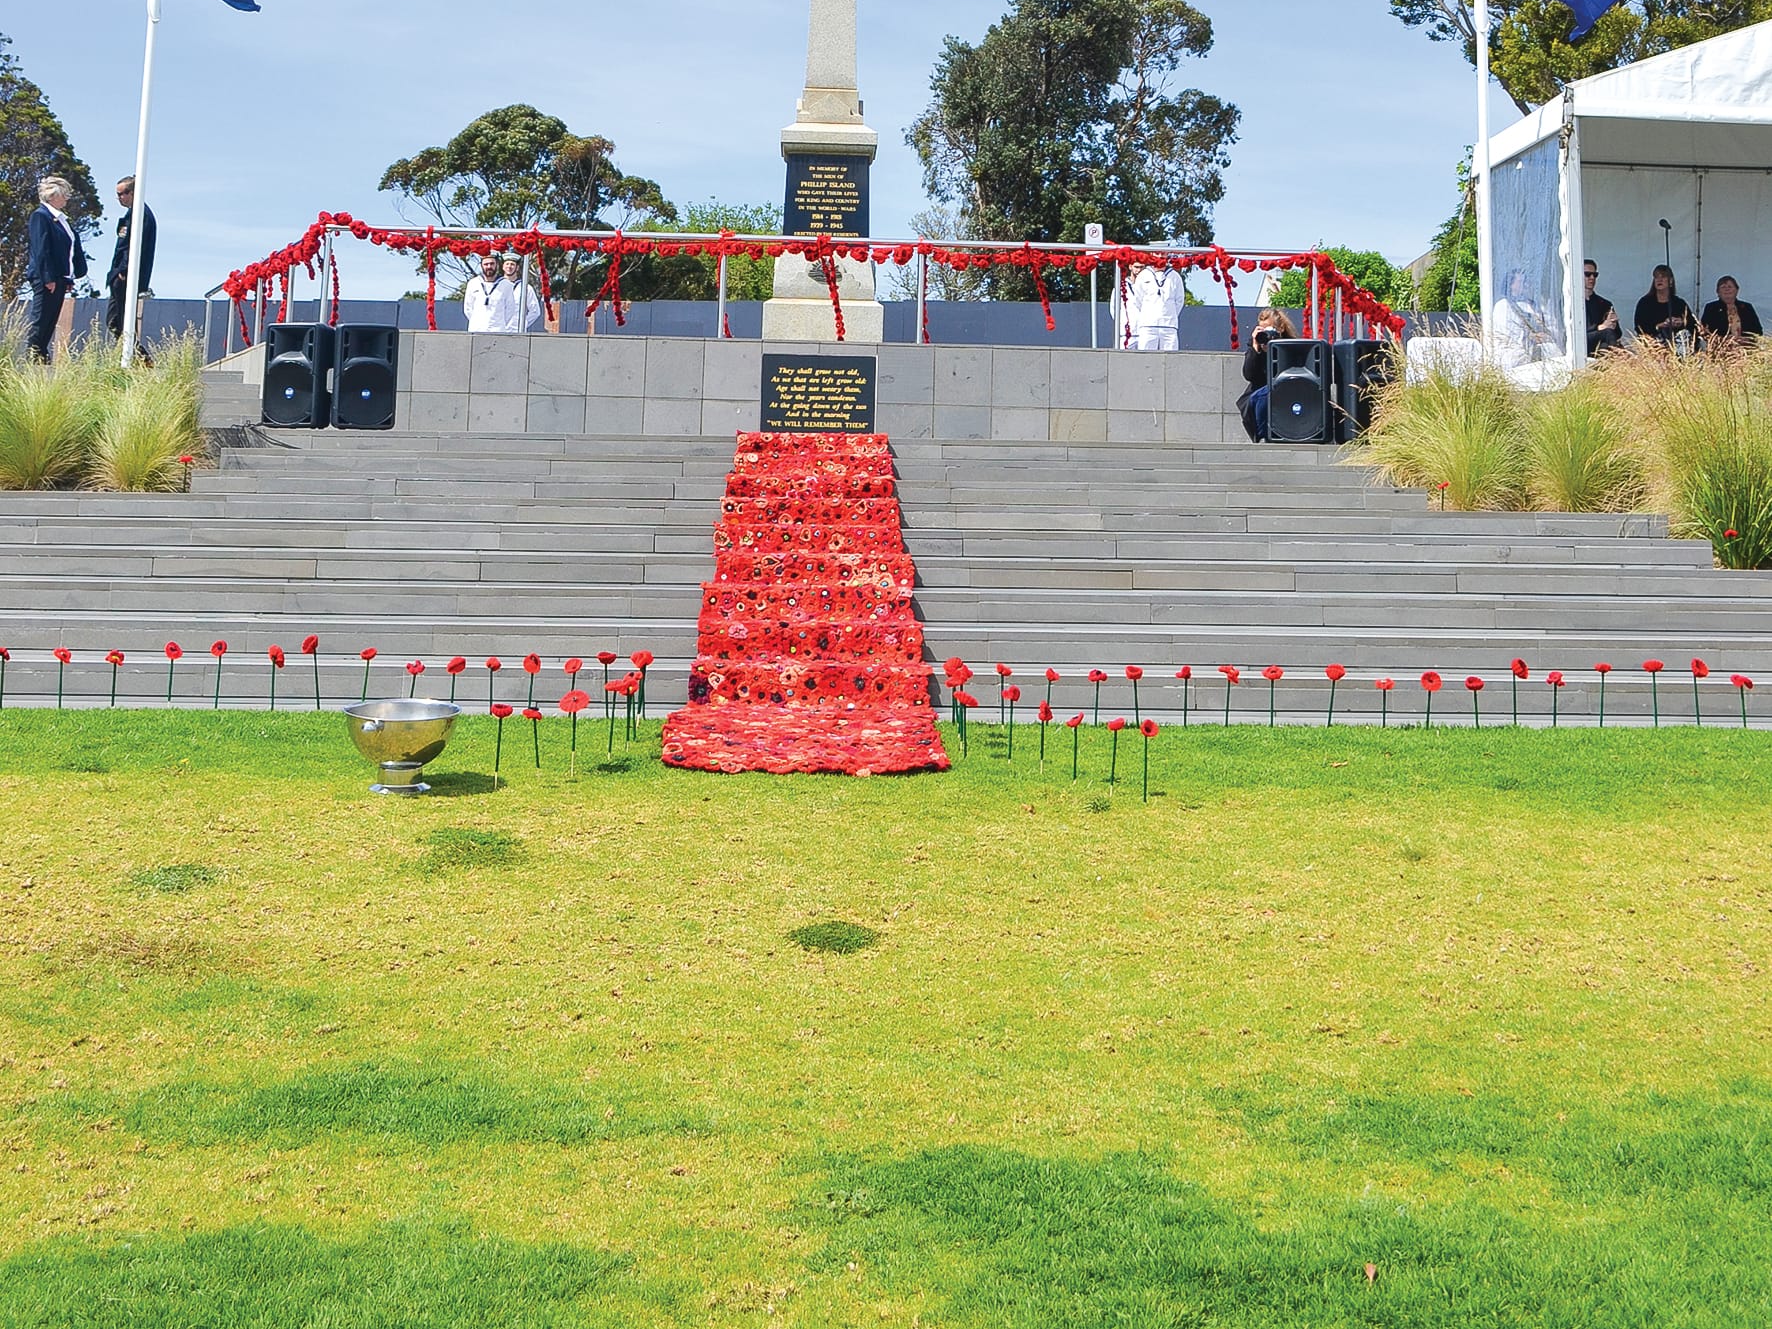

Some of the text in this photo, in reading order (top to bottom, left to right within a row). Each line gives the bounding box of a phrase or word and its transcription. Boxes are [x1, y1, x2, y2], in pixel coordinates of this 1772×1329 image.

[779, 367, 795, 375] They
[822, 377, 834, 385] left
[832, 403, 841, 411] of
[824, 412, 850, 420] morning
